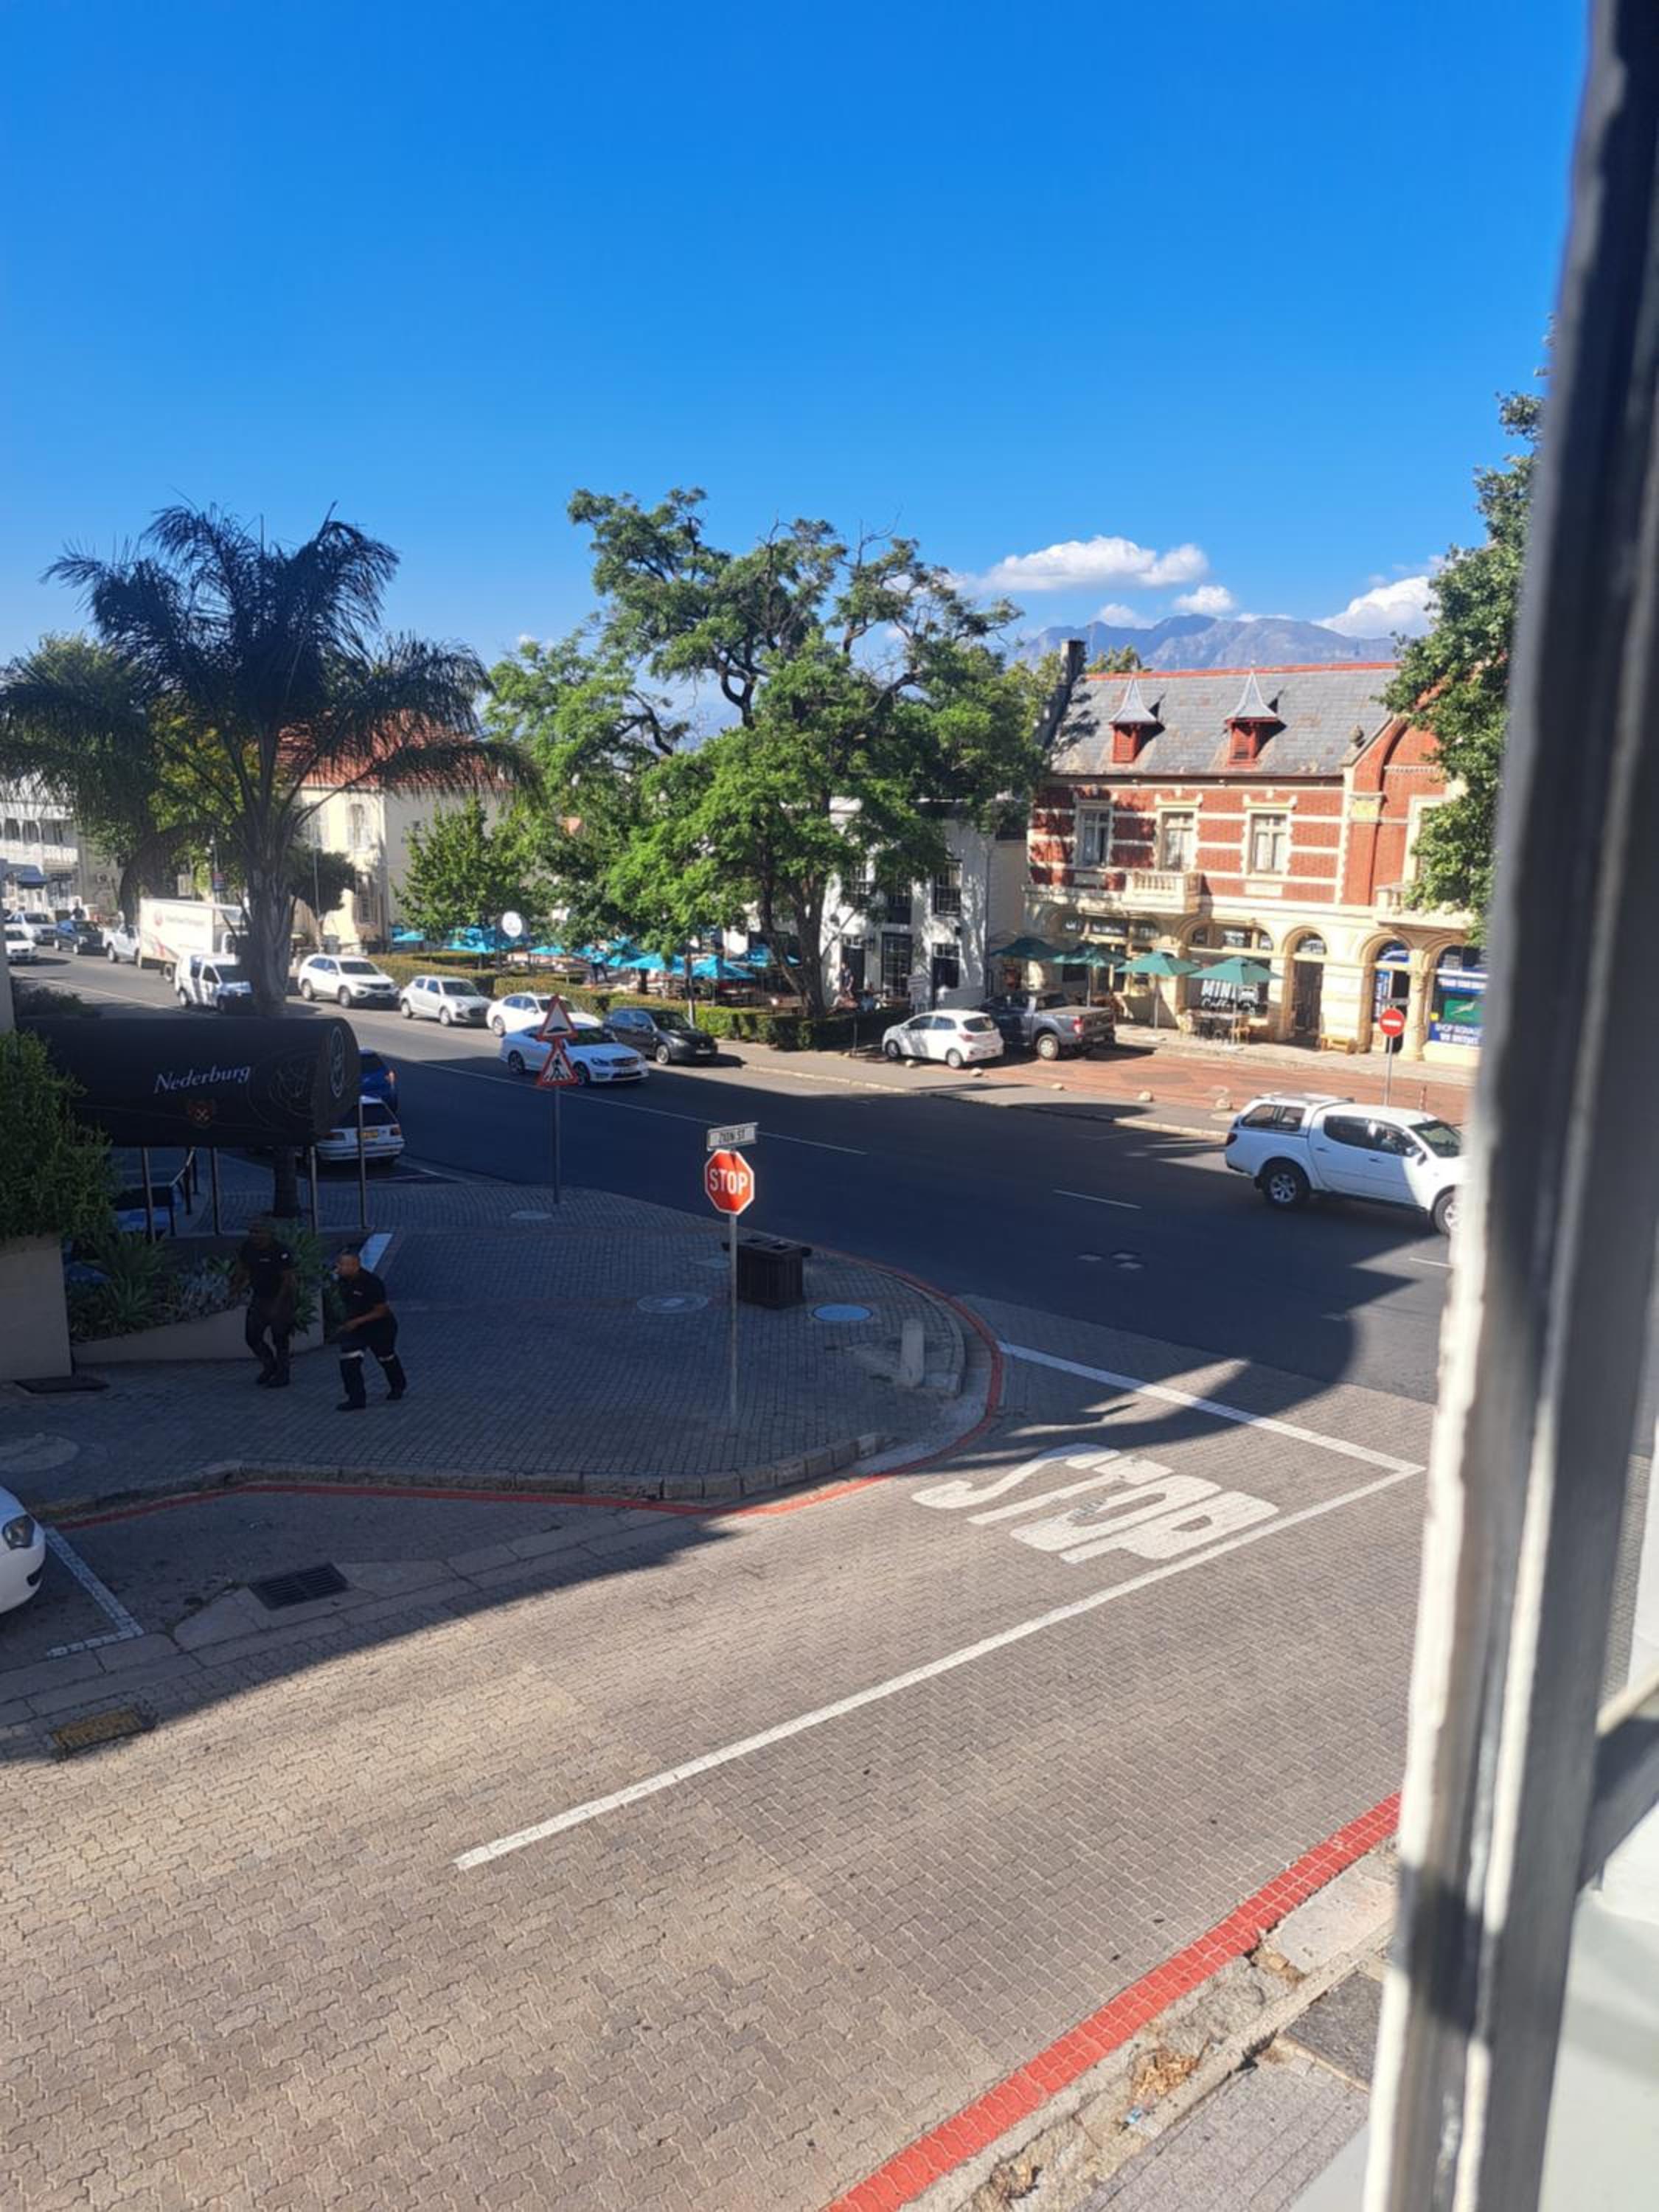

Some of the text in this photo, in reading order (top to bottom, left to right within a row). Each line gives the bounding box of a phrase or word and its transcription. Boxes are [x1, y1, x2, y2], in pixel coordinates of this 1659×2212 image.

[153, 1065, 251, 1093] Nederburg
[709, 1169, 748, 1194] STOP
[911, 1443, 1279, 1565] STOP
